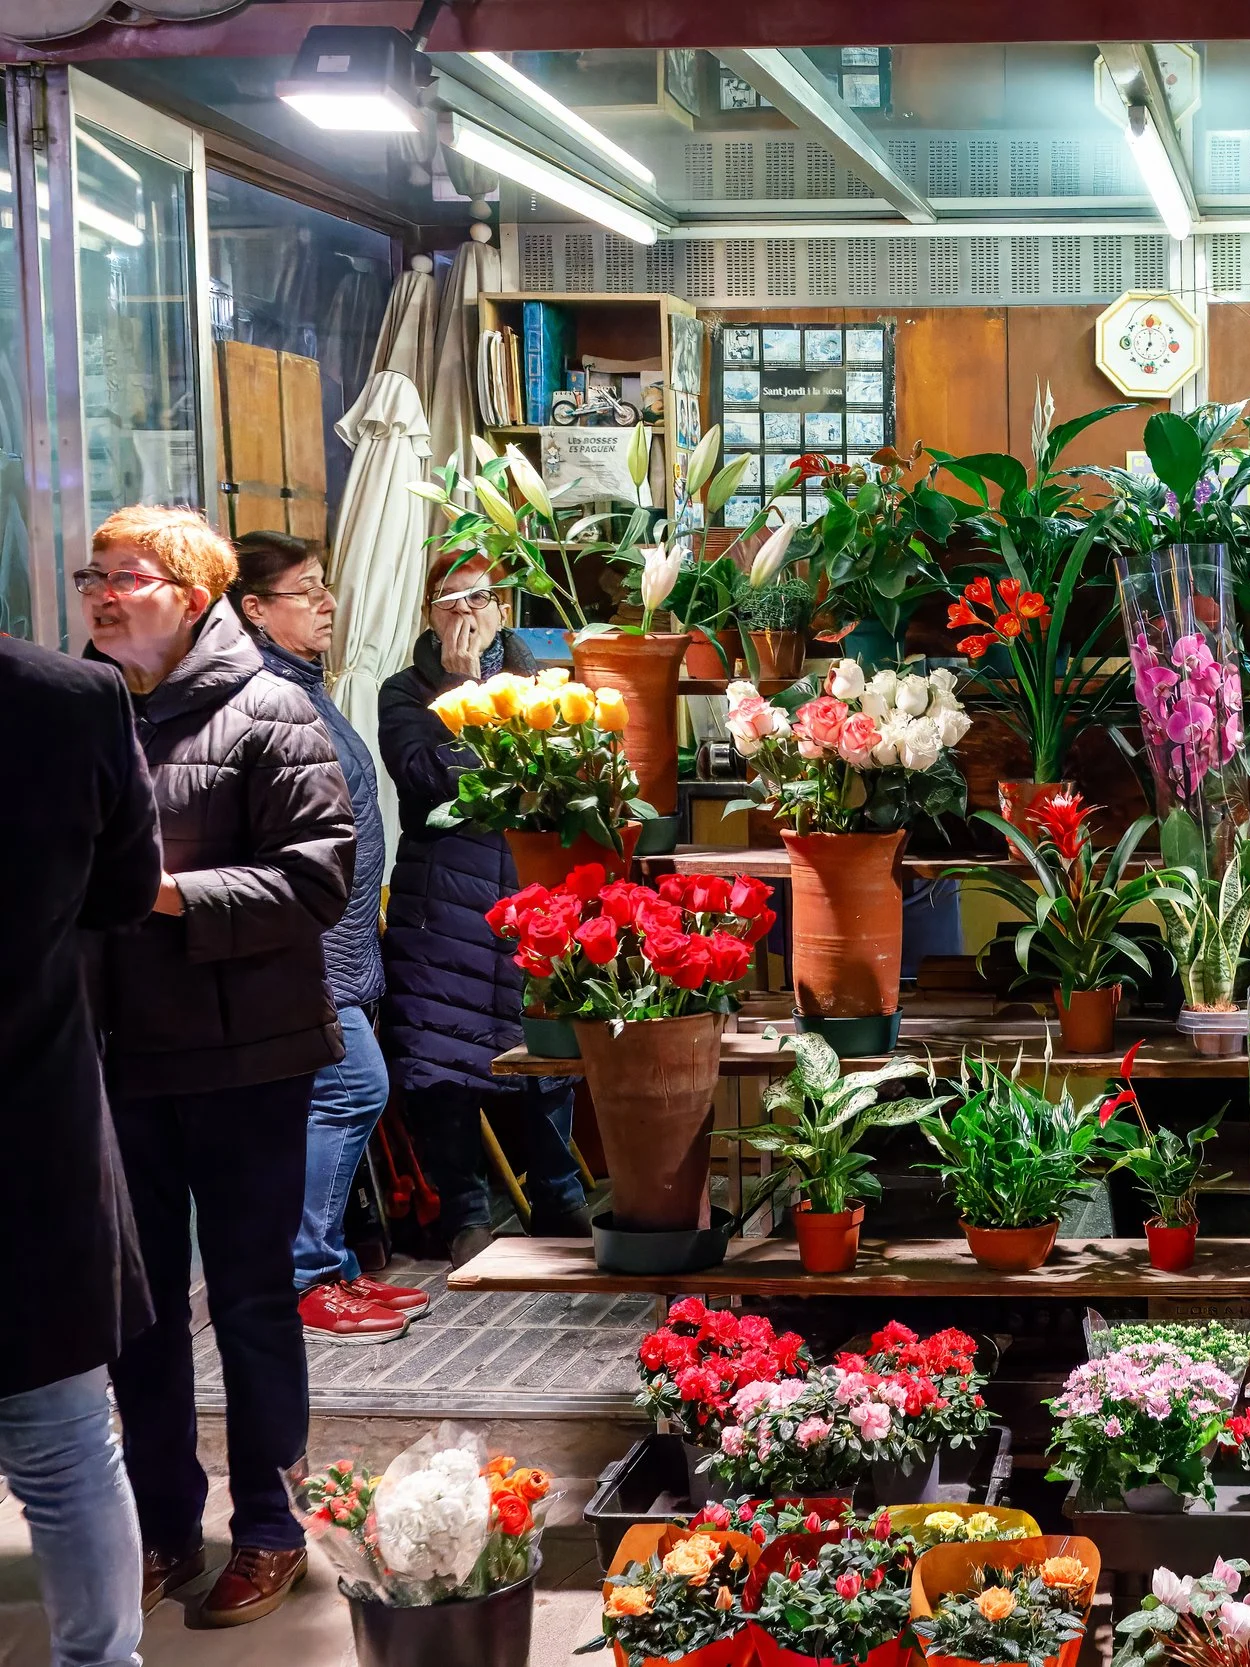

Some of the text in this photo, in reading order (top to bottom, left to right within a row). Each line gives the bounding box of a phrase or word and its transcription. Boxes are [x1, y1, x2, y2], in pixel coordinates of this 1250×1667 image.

[763, 387, 782, 396] Sant
[783, 387, 805, 397] Jordi
[823, 387, 843, 395] Rosa
